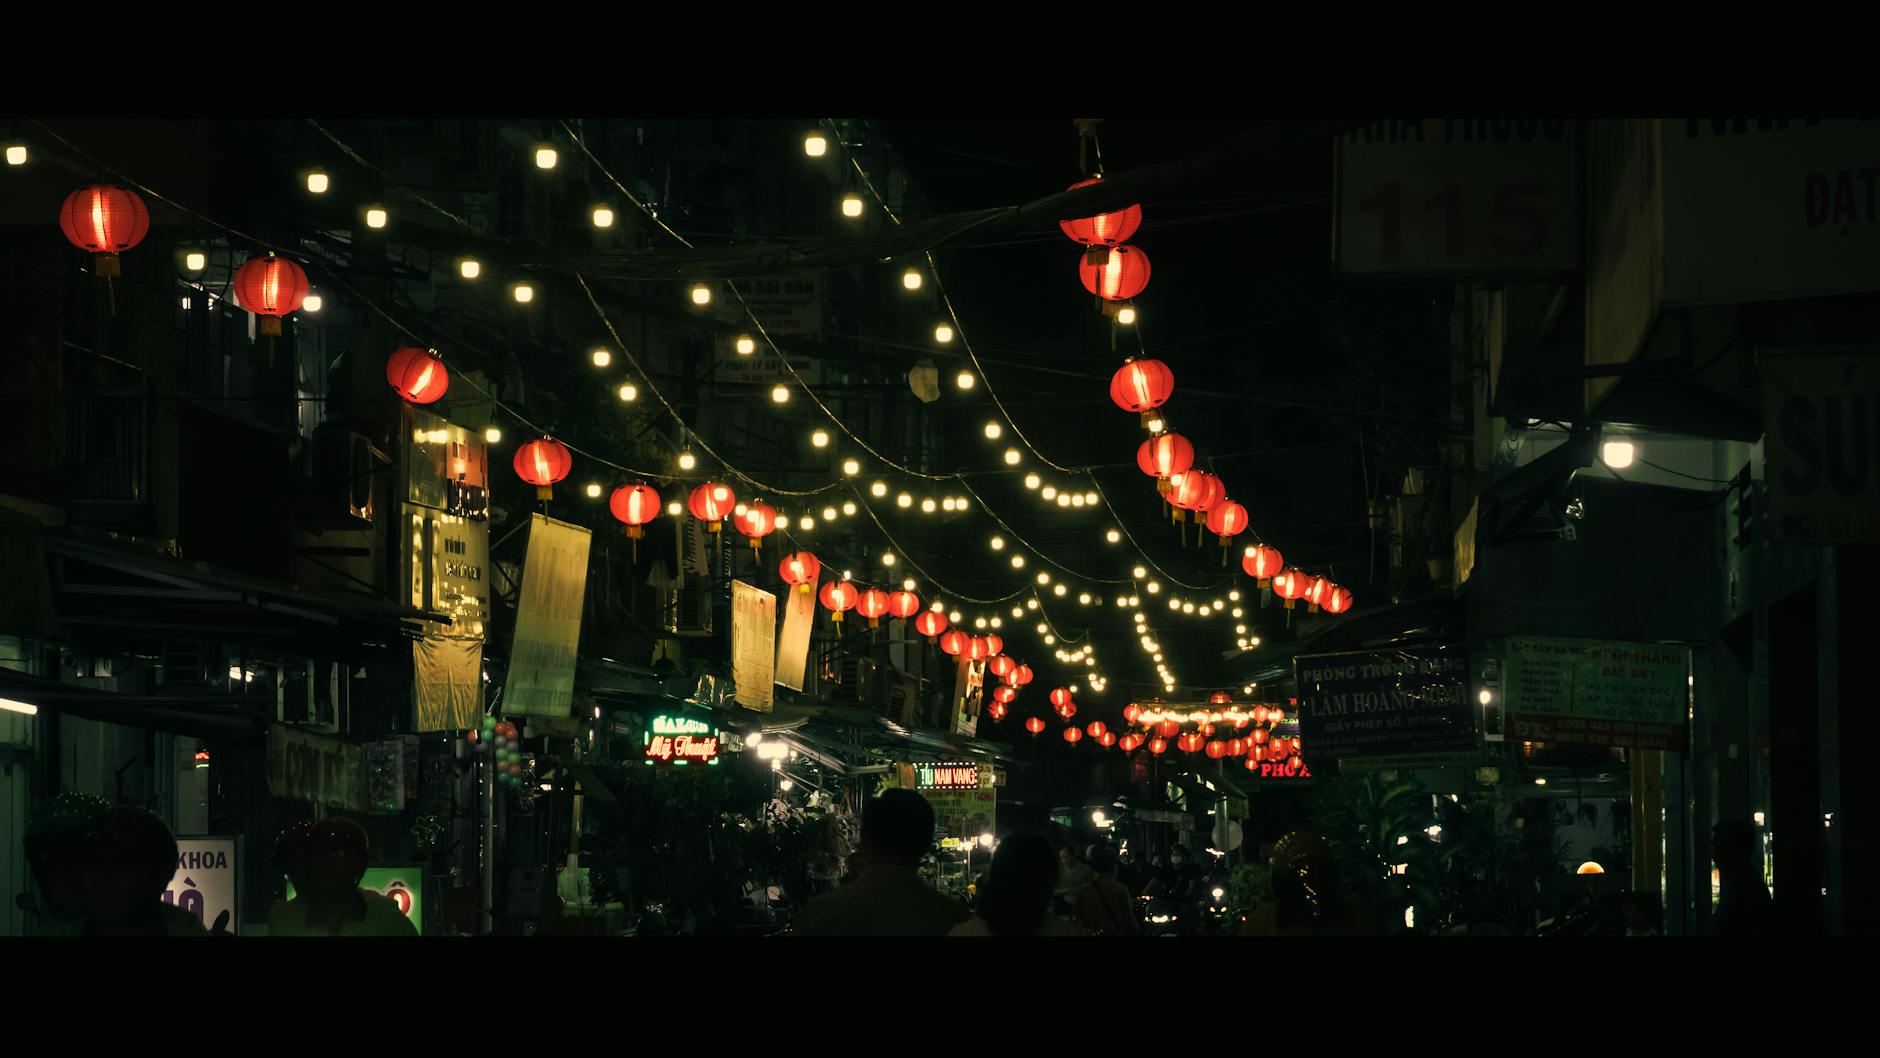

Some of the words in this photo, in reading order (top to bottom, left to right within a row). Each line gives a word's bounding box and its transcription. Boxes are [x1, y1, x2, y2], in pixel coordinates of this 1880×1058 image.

[1360, 181, 1553, 258] 115
[1303, 664, 1356, 682] PHÒNG
[1311, 689, 1348, 717] LÂM
[1353, 684, 1415, 713] HOÀNG
[934, 768, 952, 785] NAM
[953, 768, 976, 785] VANG
